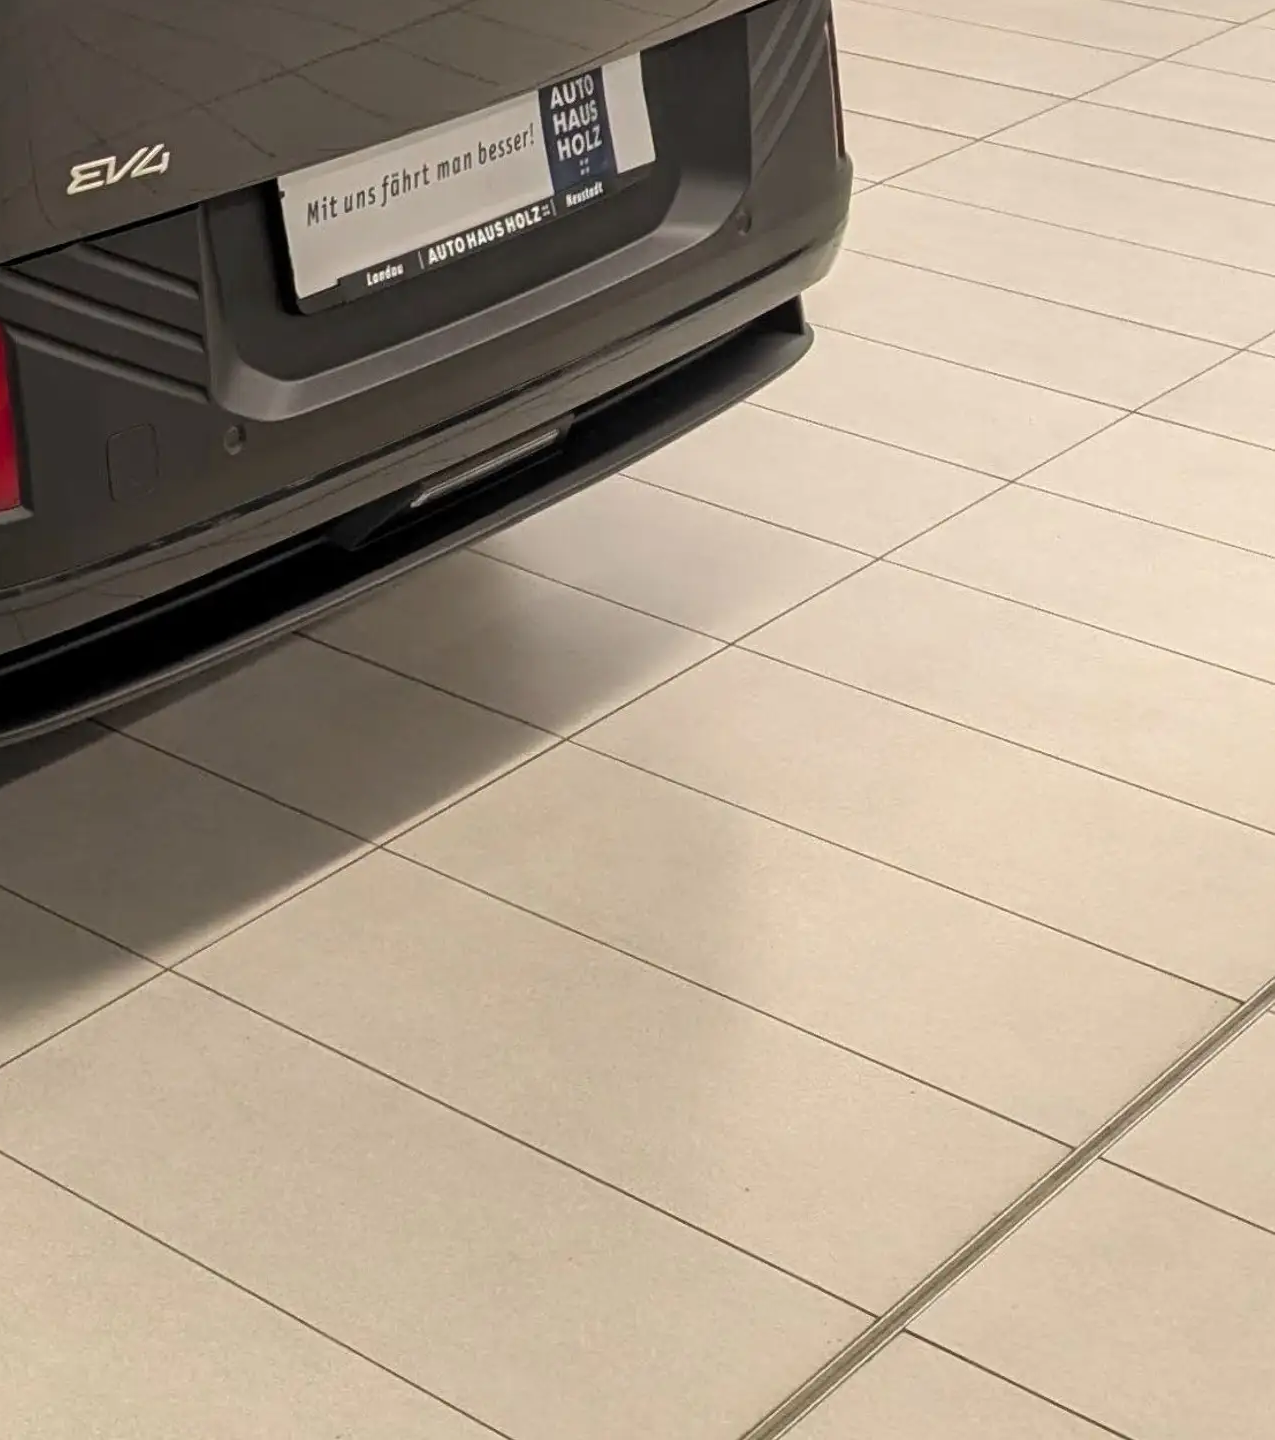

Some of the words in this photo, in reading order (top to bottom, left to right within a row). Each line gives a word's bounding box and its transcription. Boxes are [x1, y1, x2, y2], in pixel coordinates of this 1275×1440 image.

[550, 74, 595, 110] AUTO
[552, 99, 599, 136] HAUS
[556, 124, 603, 162] HOLZ
[66, 143, 171, 196] EV4
[306, 196, 338, 228] Mit
[343, 184, 377, 215] uns
[381, 163, 431, 208] fährt
[436, 151, 473, 182] man
[477, 122, 535, 165] besser!
[366, 263, 404, 287] Landau
[427, 236, 466, 266] AUTO
[466, 221, 506, 250] HAUS
[505, 206, 543, 234] HOLZ
[565, 181, 604, 208] Neustadt
